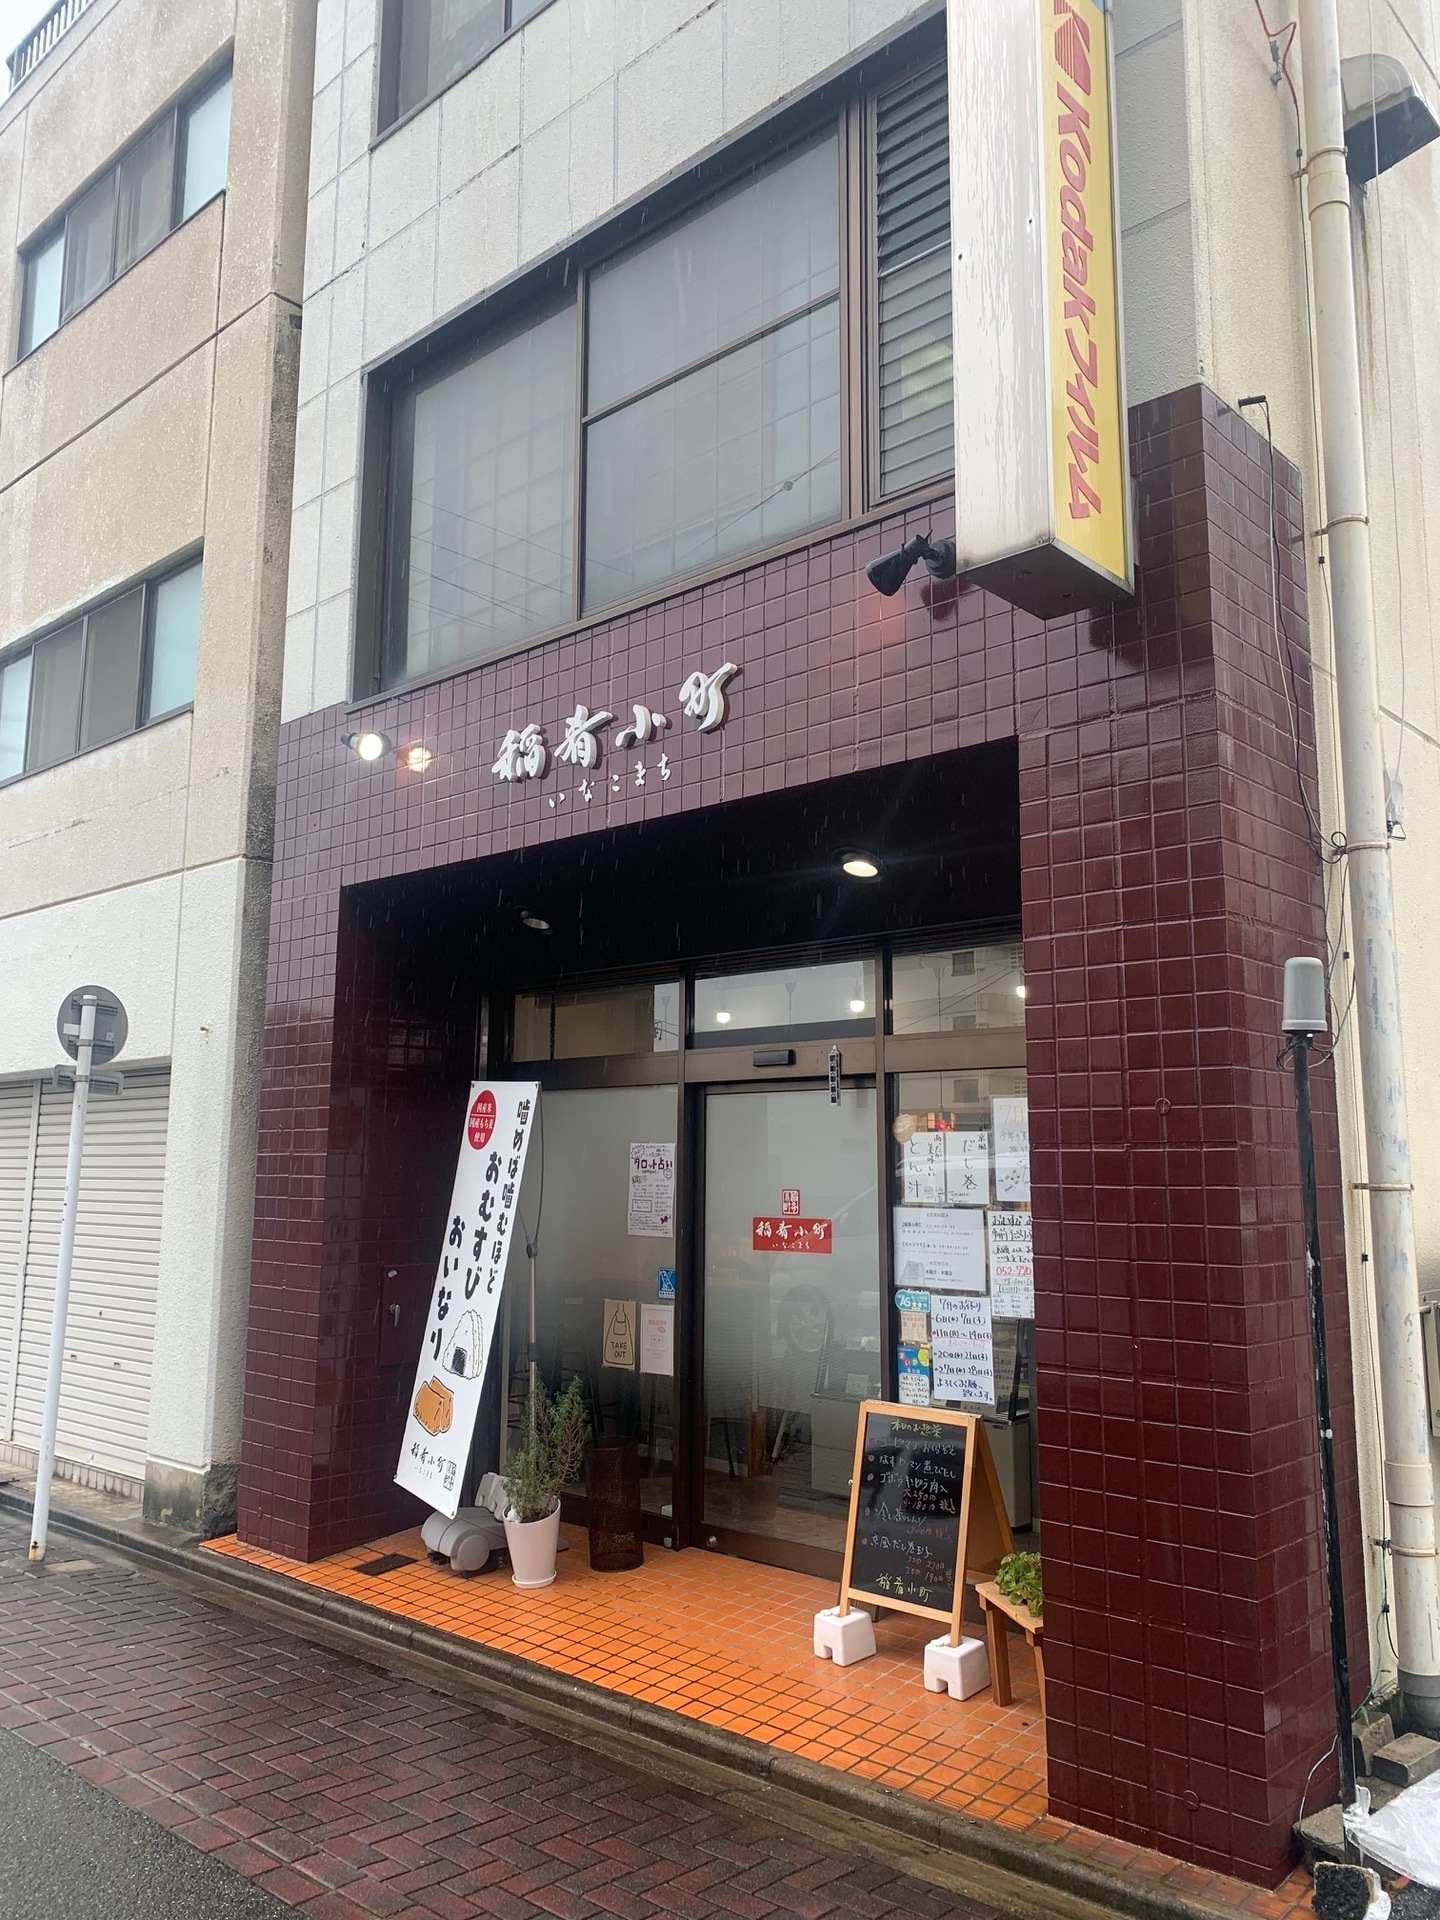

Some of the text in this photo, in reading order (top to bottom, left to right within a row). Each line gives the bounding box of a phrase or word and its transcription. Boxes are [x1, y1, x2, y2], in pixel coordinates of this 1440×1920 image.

[548, 752, 672, 809] いなこまち
[476, 1102, 493, 1114] 国産米
[468, 1117, 494, 1130] 国産もち麦
[473, 1131, 486, 1143] 使用
[908, 1139, 923, 1199] とん汁
[464, 1151, 503, 1300] おむすび
[429, 1215, 466, 1361] おいなり
[610, 1341, 628, 1350] TAKE
[613, 1350, 627, 1359] OUT
